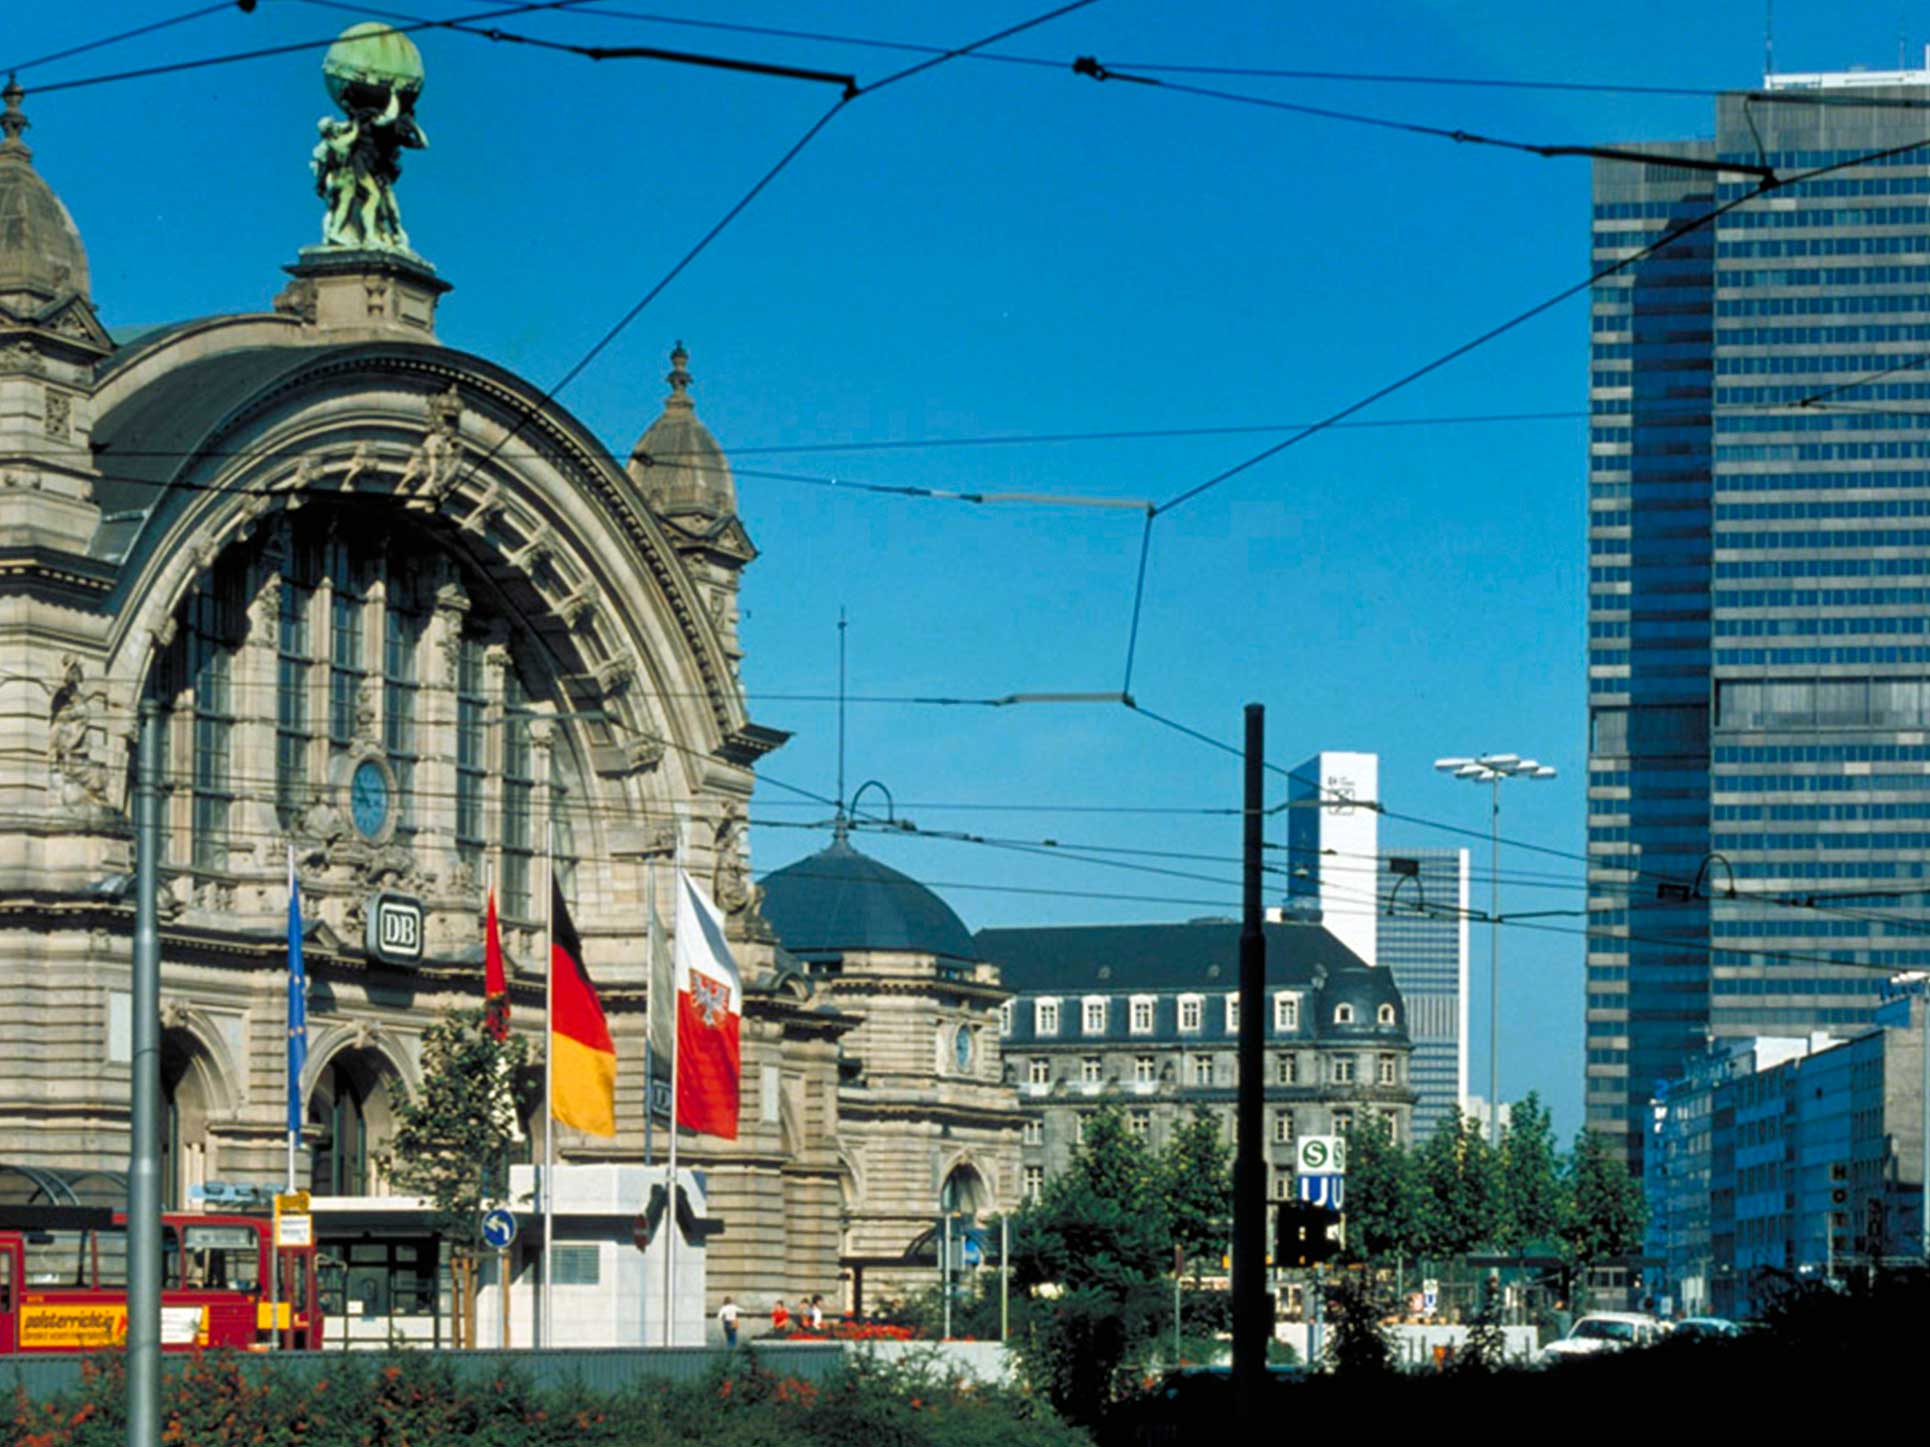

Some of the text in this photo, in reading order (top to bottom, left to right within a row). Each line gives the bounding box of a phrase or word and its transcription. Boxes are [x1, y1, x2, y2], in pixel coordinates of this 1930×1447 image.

[385, 913, 415, 945] DB
[1305, 1142, 1324, 1165] S
[1301, 1177, 1329, 1207] U
[1332, 1177, 1345, 1209] U
